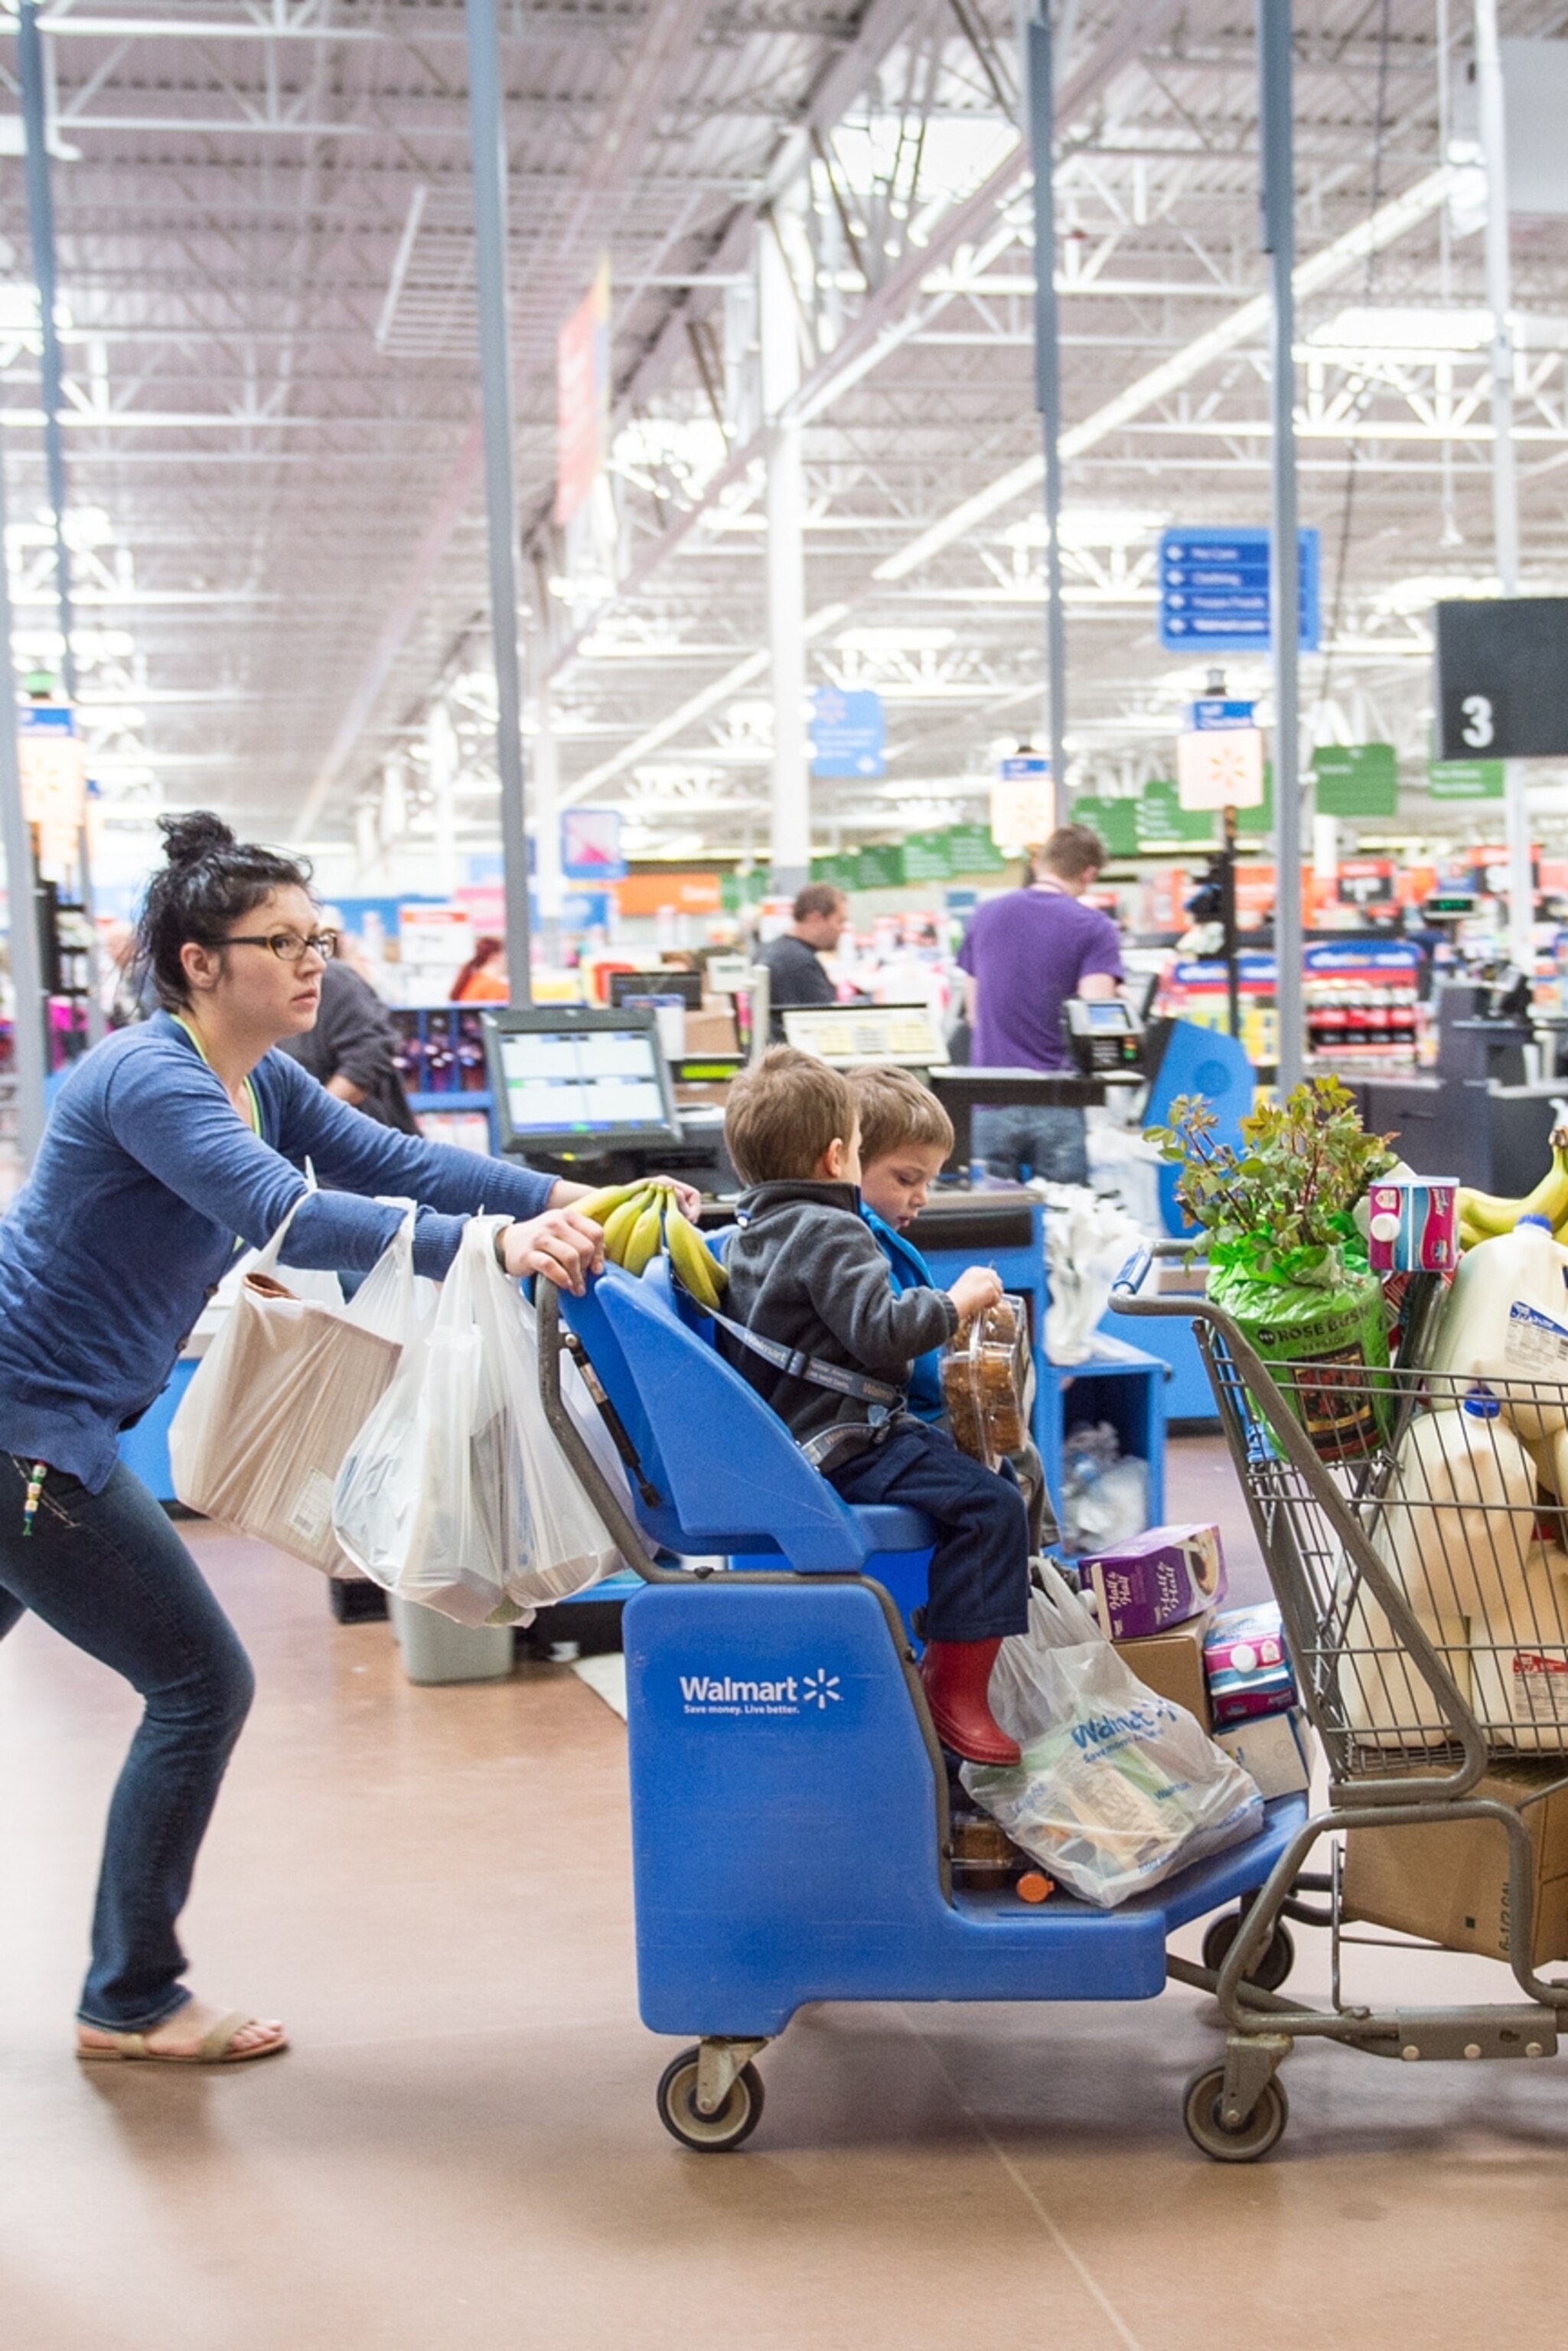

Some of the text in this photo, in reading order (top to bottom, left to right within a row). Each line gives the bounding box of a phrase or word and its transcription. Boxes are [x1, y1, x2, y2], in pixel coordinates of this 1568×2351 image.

[1462, 695, 1495, 748] 3
[1276, 1322, 1325, 1342] ROSE
[1327, 1303, 1369, 1332] BUSH
[1106, 1579, 1121, 1610] Half
[1117, 1573, 1133, 1606] Half
[1156, 1571, 1172, 1618] Half
[1165, 1565, 1180, 1609] Half
[680, 1676, 798, 1702] Walmart
[683, 1704, 800, 1716] Save money. Live better.
